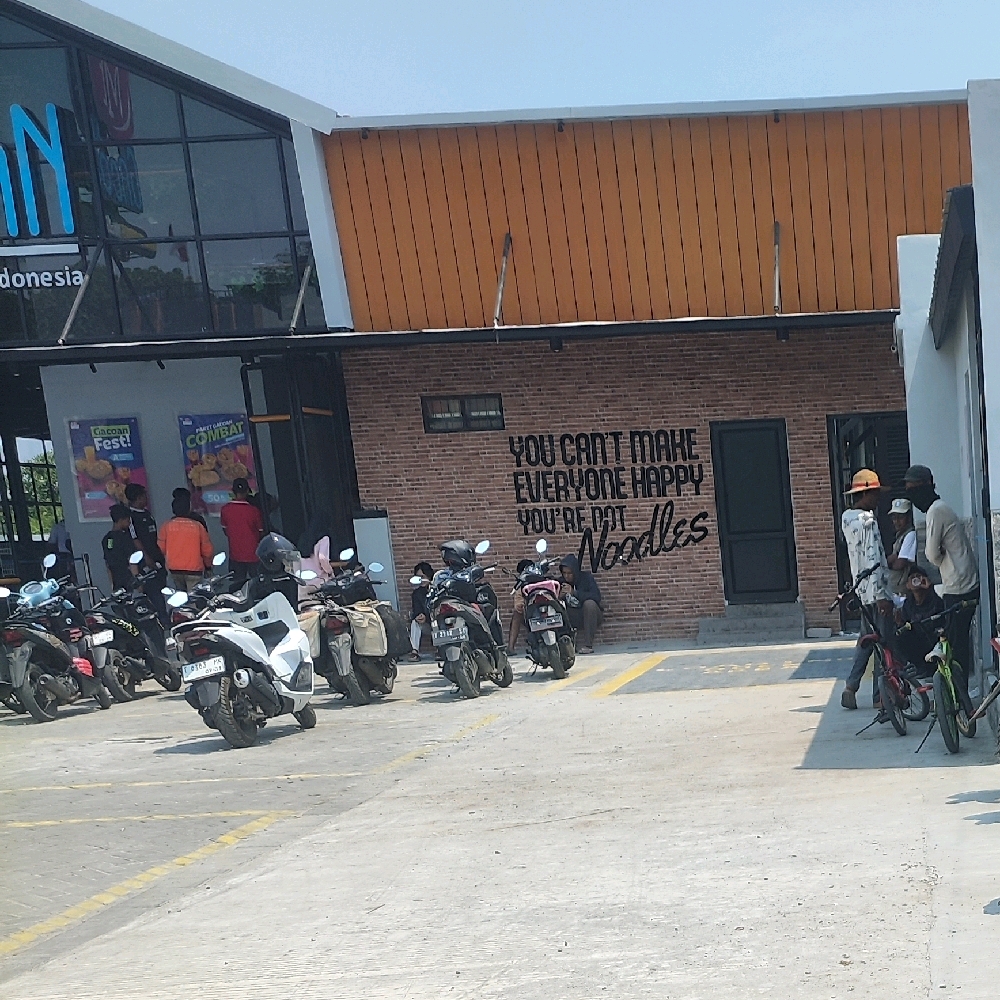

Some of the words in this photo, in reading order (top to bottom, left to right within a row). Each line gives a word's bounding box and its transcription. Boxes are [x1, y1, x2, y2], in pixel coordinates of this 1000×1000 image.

[93, 427, 129, 436] Gacoan
[94, 434, 131, 452] Fest!
[186, 421, 244, 448] COMBAT
[509, 434, 556, 467] YOU
[560, 431, 623, 465] CAN'T
[629, 428, 700, 464] MAKE
[513, 466, 628, 503] EVERYONE
[631, 464, 704, 498] HAPPY
[517, 506, 586, 535] YOU'RE
[591, 505, 626, 531] NOT
[578, 500, 709, 573] Noodles
